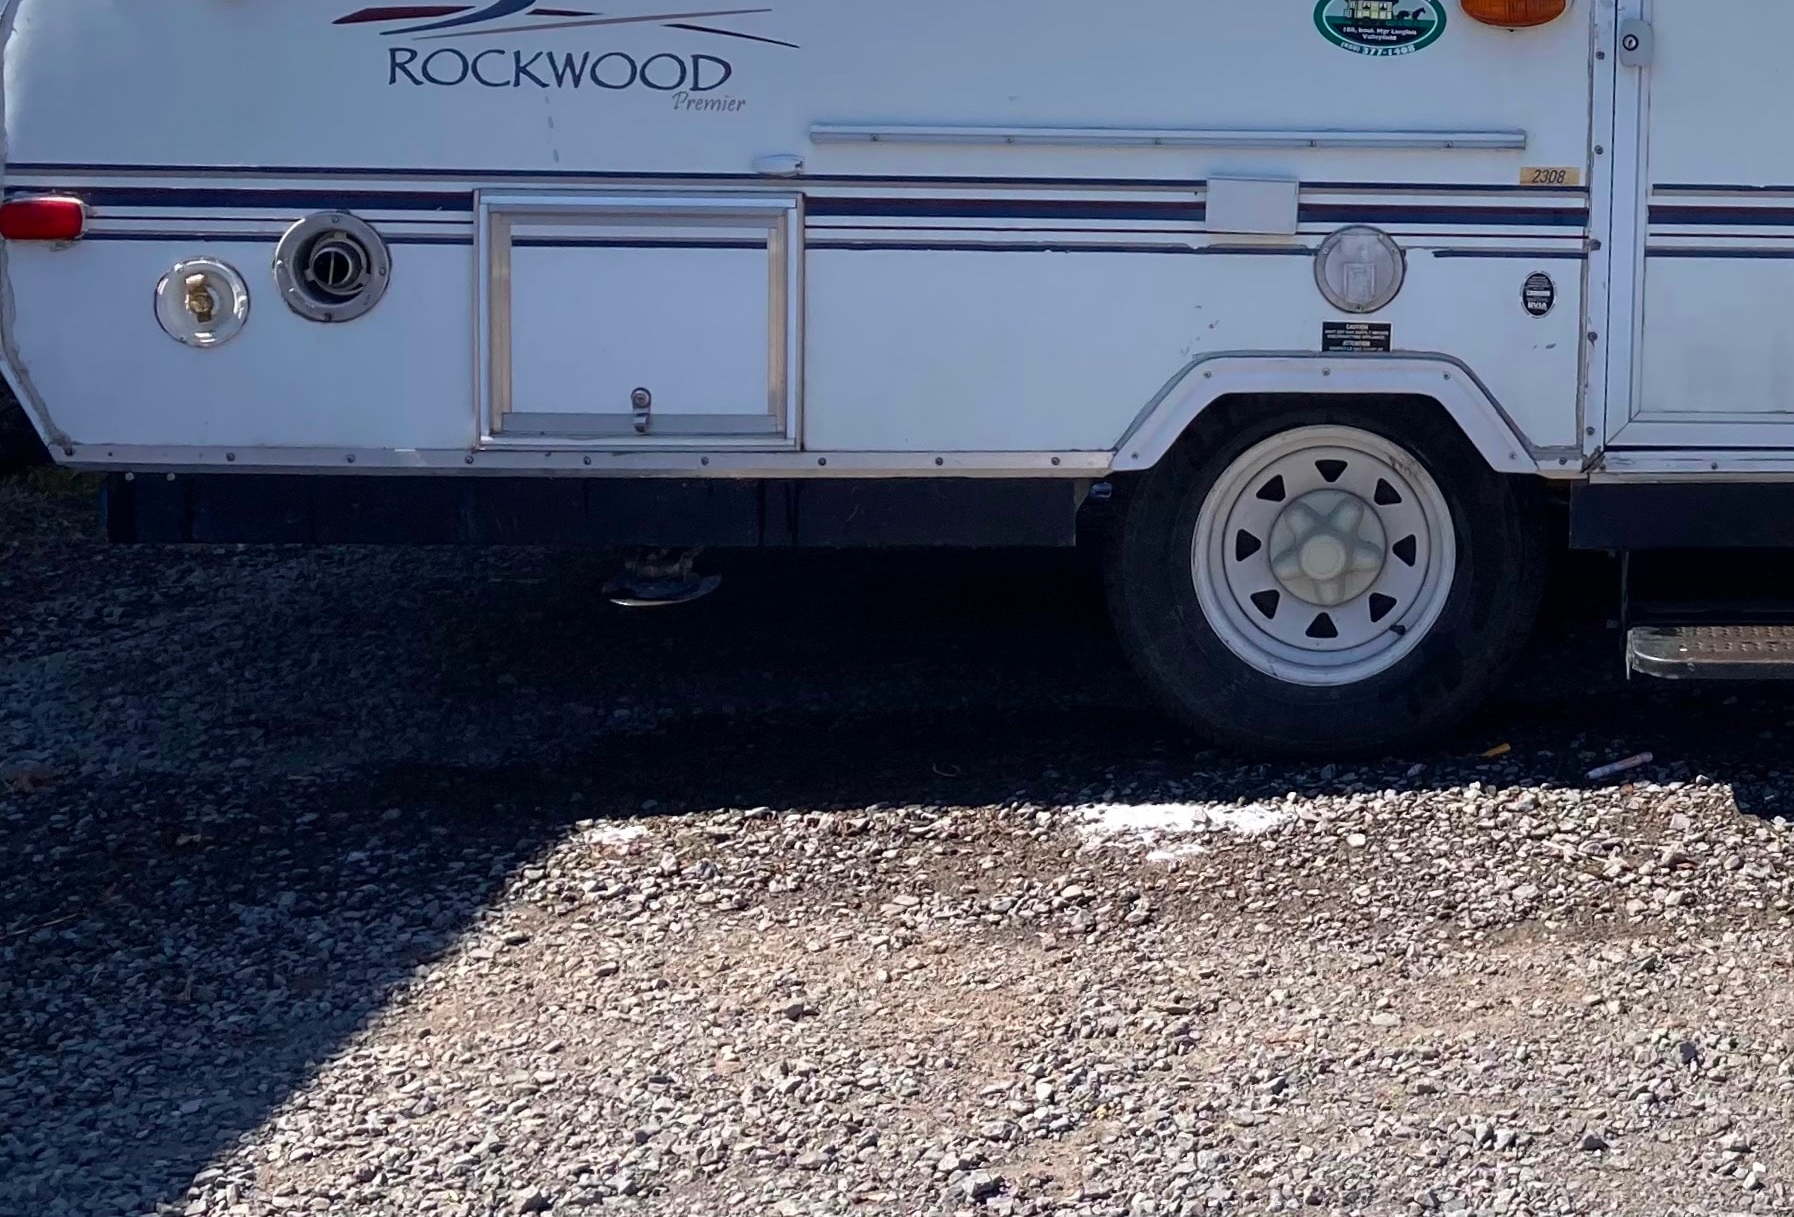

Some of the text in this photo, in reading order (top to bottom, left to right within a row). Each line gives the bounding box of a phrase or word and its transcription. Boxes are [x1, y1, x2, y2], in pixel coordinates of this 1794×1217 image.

[388, 47, 732, 91] ROCKWOOD
[672, 91, 746, 112] Premier
[1532, 169, 1566, 183] 2308
